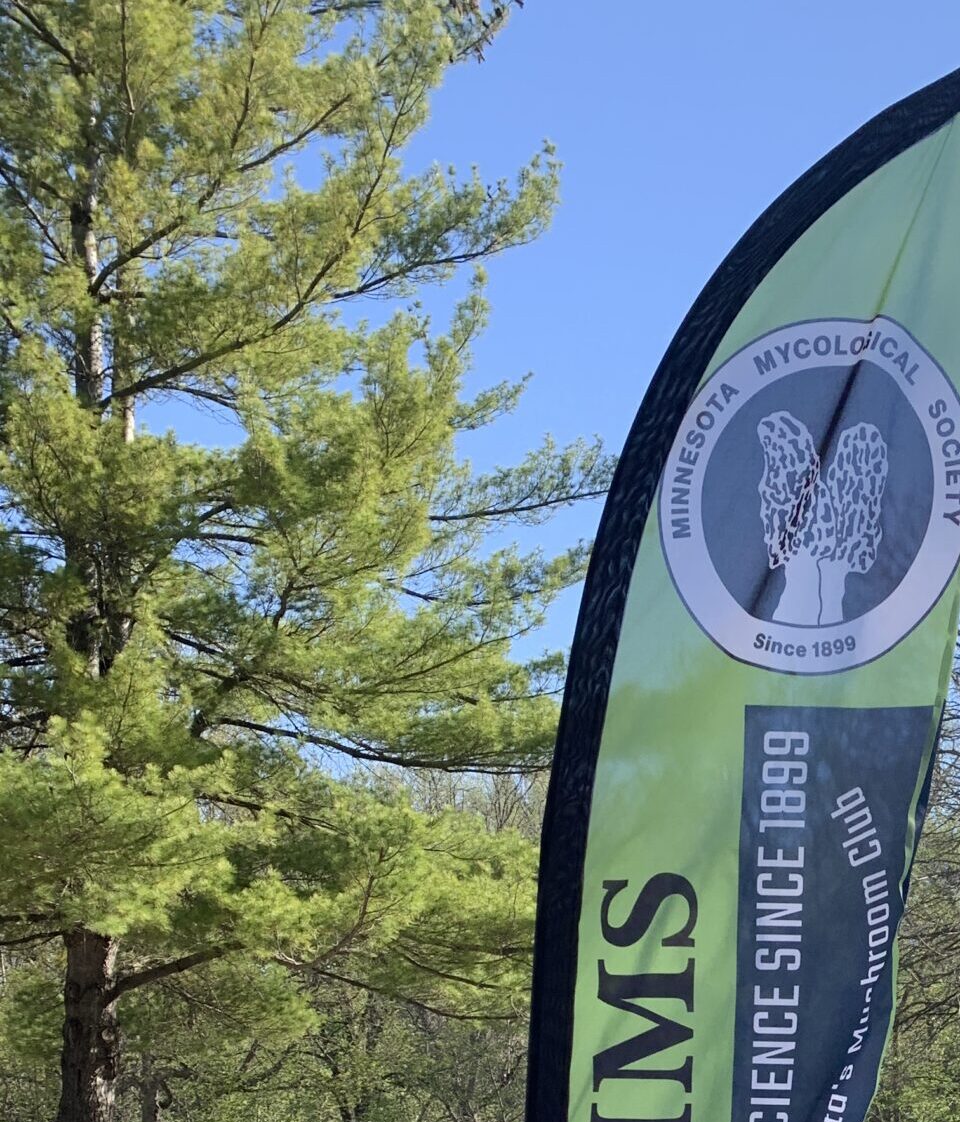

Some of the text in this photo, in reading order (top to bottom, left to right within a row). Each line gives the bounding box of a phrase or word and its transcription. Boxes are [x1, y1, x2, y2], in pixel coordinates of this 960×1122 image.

[672, 382, 740, 539] MINNESOTA
[753, 632, 857, 659] Since 1899
[759, 730, 810, 834] 1899
[831, 786, 882, 868] Club
[754, 846, 805, 971] SINCE
